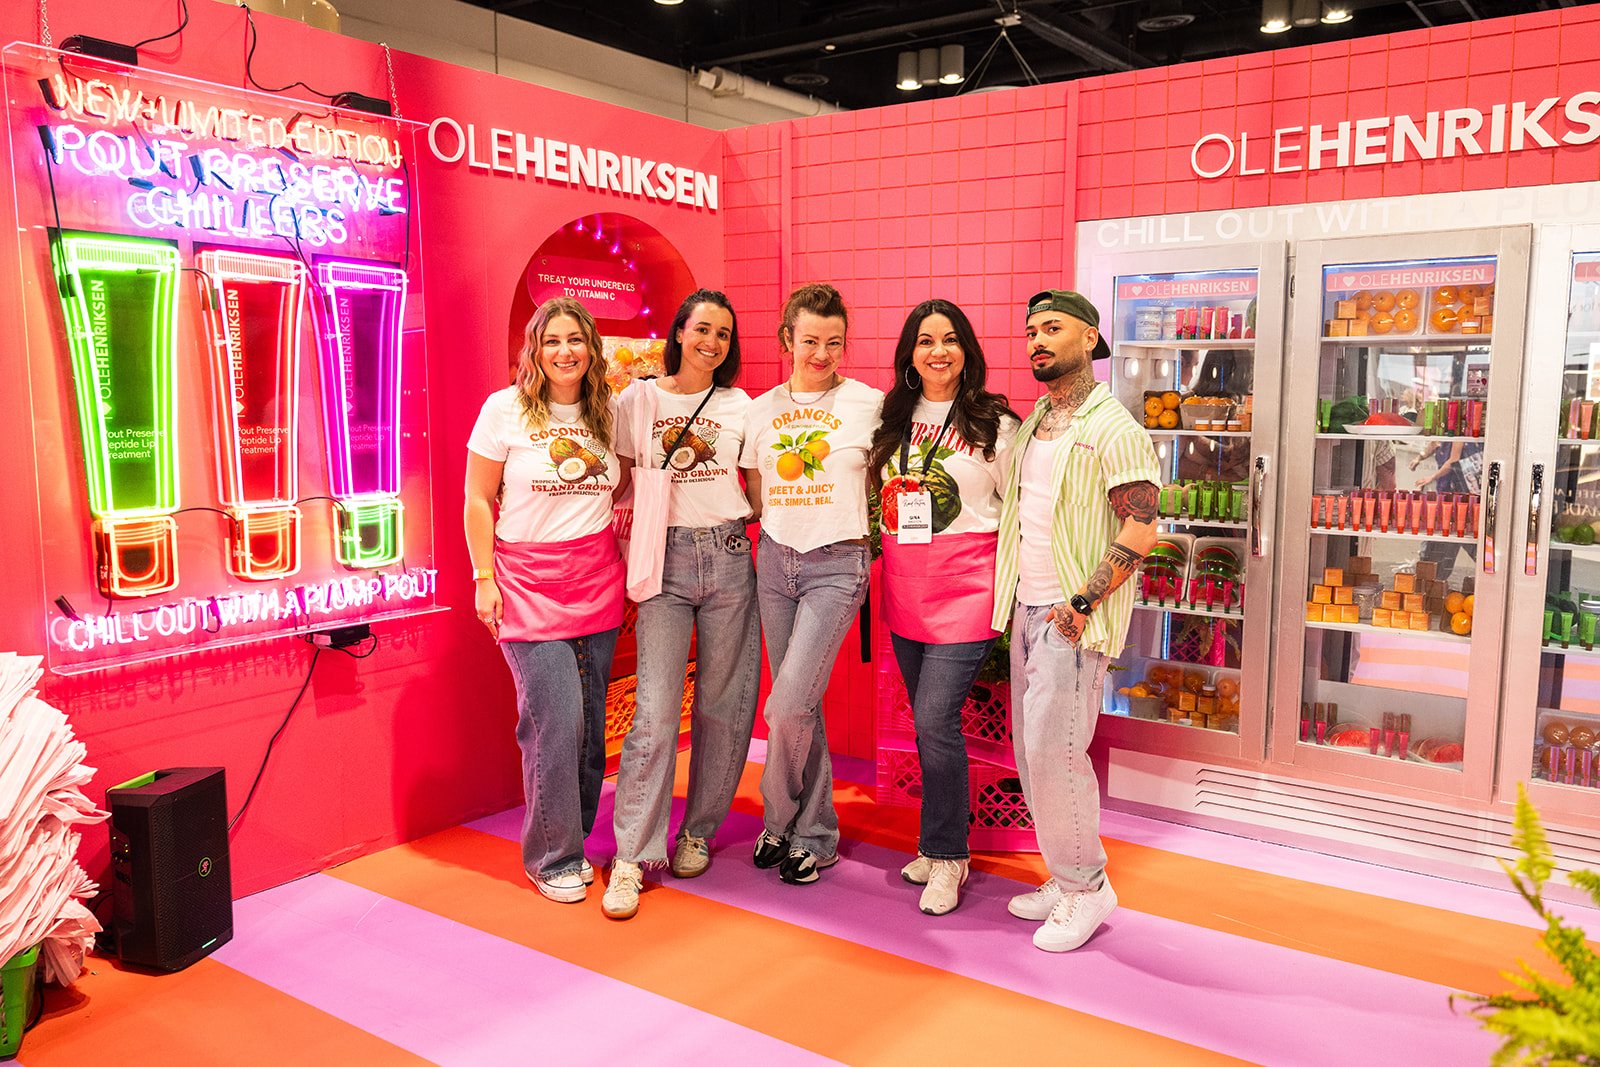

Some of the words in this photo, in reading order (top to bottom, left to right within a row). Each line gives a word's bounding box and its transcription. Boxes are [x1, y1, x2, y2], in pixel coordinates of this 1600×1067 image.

[56, 124, 188, 179] POUT
[203, 148, 406, 213] PRESERVE
[428, 117, 718, 210] OLEHENRIKSEN
[147, 186, 347, 246] CHILLERS
[1096, 215, 1205, 248] CHILL
[1215, 207, 1304, 240] OUT
[1314, 200, 1433, 233] WITH
[538, 273, 566, 284] TREAT
[568, 277, 590, 287] YOUR
[591, 279, 635, 292] UNDEREYES
[1359, 268, 1485, 287] OLEHENRIKSEN
[563, 287, 575, 297] TO
[576, 289, 609, 300] VITAMIN
[609, 292, 616, 301] C
[1146, 280, 1250, 297] OLEHENRIKSEN
[91, 279, 112, 399] OLEHENRIKSEN
[227, 289, 245, 399] OLEHENRIKSEN
[340, 297, 354, 400] OLEHENRIKSEN
[652, 416, 722, 430] OCONUTS
[772, 408, 842, 430] ORANGES
[105, 430, 124, 438] out
[126, 428, 165, 438] Presere
[529, 427, 597, 442] COCONU
[108, 439, 139, 450] eptide
[109, 450, 151, 459] reatment
[690, 468, 728, 478] GROWN
[531, 483, 574, 492] ISLAND
[577, 483, 614, 492] GROWN
[796, 485, 803, 495] &
[806, 484, 834, 495] JUICY
[67, 612, 149, 651] CHILL
[156, 601, 212, 636] OUT
[217, 588, 280, 628] WITH
[283, 589, 301, 617] A
[304, 577, 383, 614] PLUMP
[384, 569, 439, 602] POUT
